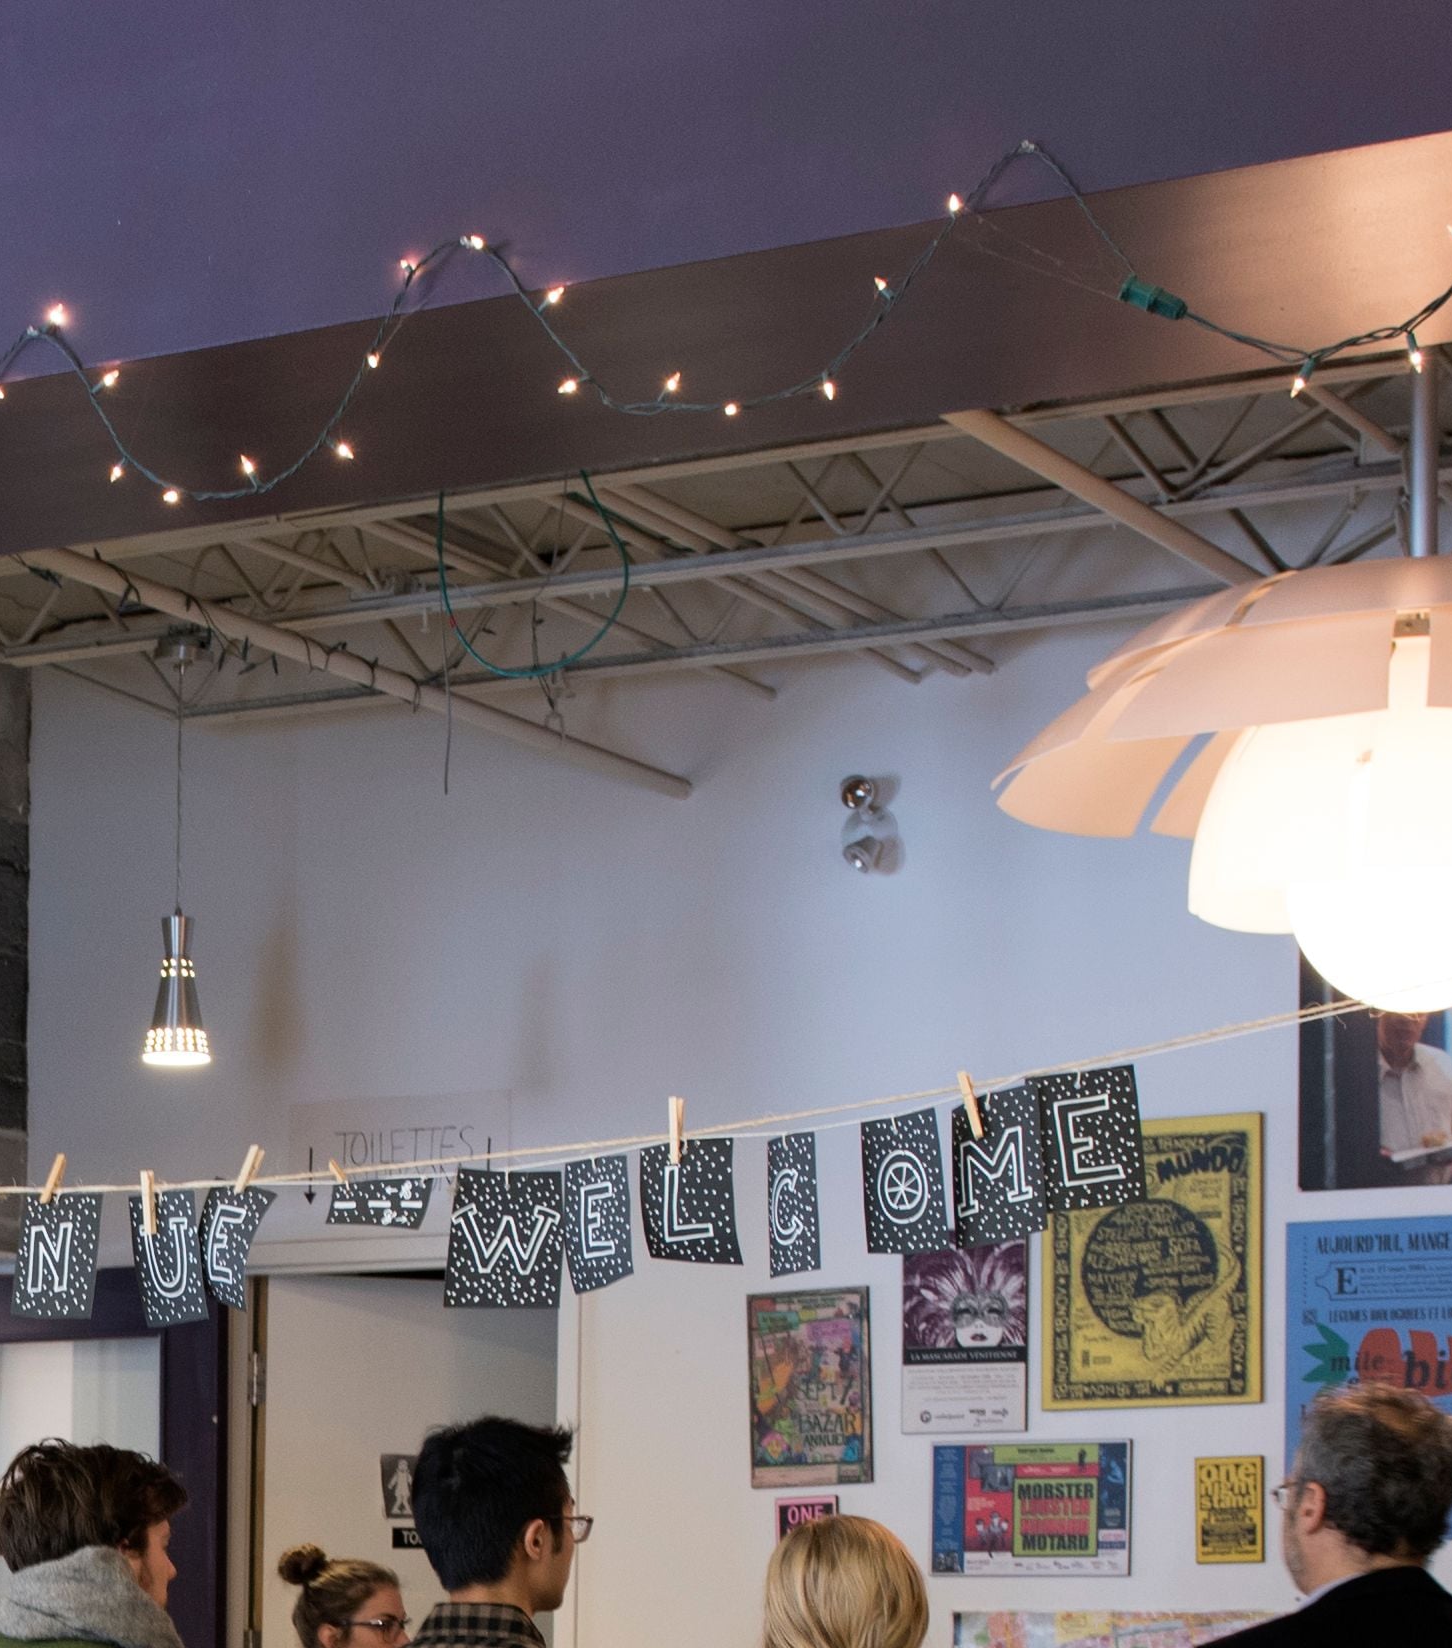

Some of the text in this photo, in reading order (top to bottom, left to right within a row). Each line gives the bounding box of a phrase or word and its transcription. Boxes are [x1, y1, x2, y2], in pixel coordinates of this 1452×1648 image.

[335, 1125, 475, 1167] TOILETTES
[1156, 1146, 1246, 1183] MUNDO
[451, 1093, 1126, 1275] WELCOME
[799, 1413, 857, 1434] BAZAR
[1200, 1464, 1257, 1482] one
[1018, 1483, 1094, 1499] MOBSTER
[787, 1504, 824, 1525] ONE
[1022, 1535, 1089, 1551] MOTARD
